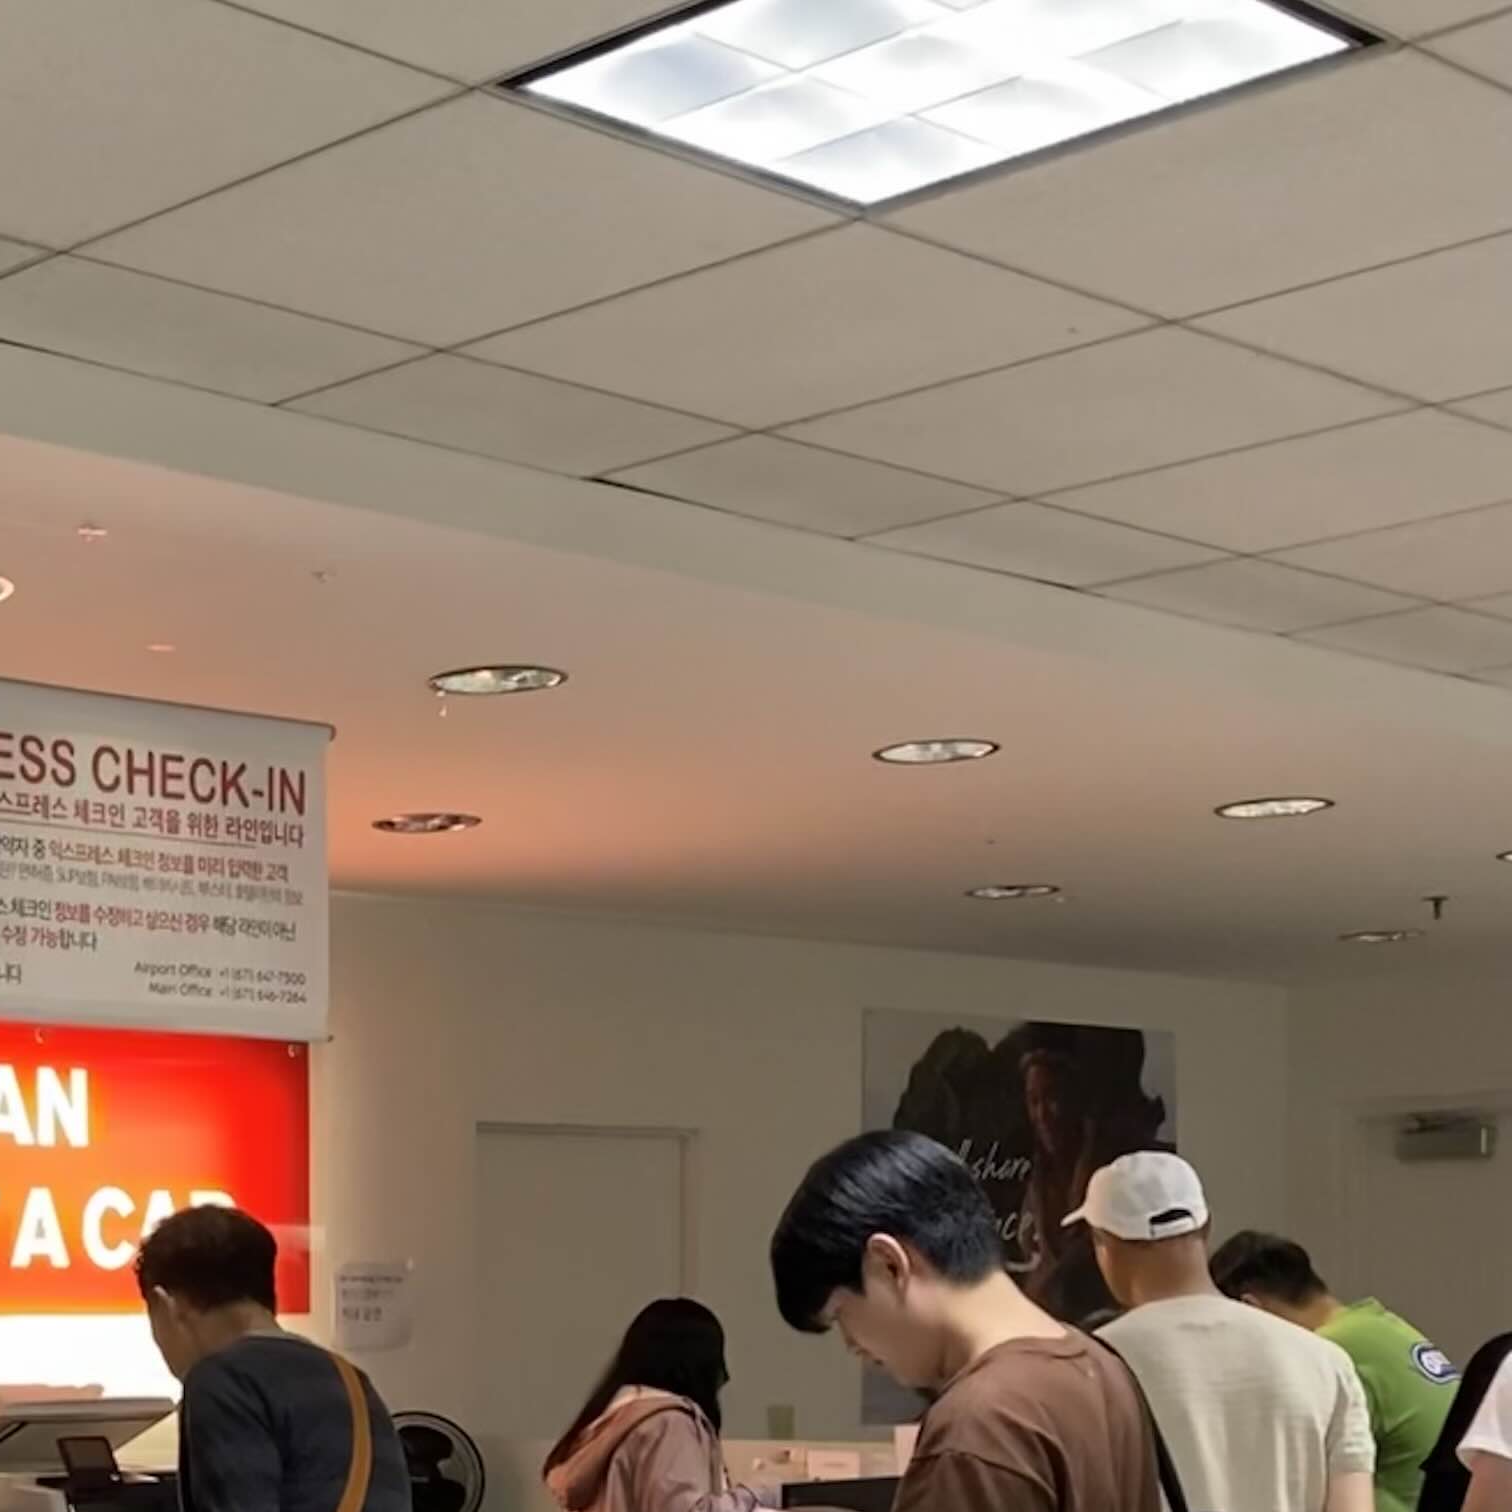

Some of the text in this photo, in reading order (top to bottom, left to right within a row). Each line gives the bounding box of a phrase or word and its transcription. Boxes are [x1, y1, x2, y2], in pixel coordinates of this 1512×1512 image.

[91, 745, 306, 817] CHECK-IN
[74, 799, 126, 829] 체크인
[132, 806, 181, 836] 고객을
[187, 811, 219, 839] 위한
[225, 816, 304, 848] 라인입니다
[33, 837, 46, 860] 중
[49, 840, 115, 866] 익스프레스
[118, 848, 155, 871] 체크인
[158, 852, 194, 875] 정보를
[198, 856, 225, 878] 미리
[265, 863, 289, 883] 고객
[10, 898, 52, 921] 체크인
[55, 902, 90, 924] 정보를
[185, 913, 210, 934] 경우
[1, 923, 28, 947] 수정
[30, 927, 98, 952] 가능합니다
[134, 961, 177, 977] Airport
[178, 963, 212, 978] Office
[148, 981, 177, 996] Main
[178, 983, 213, 998] Office
[10, 1186, 71, 1269] A
